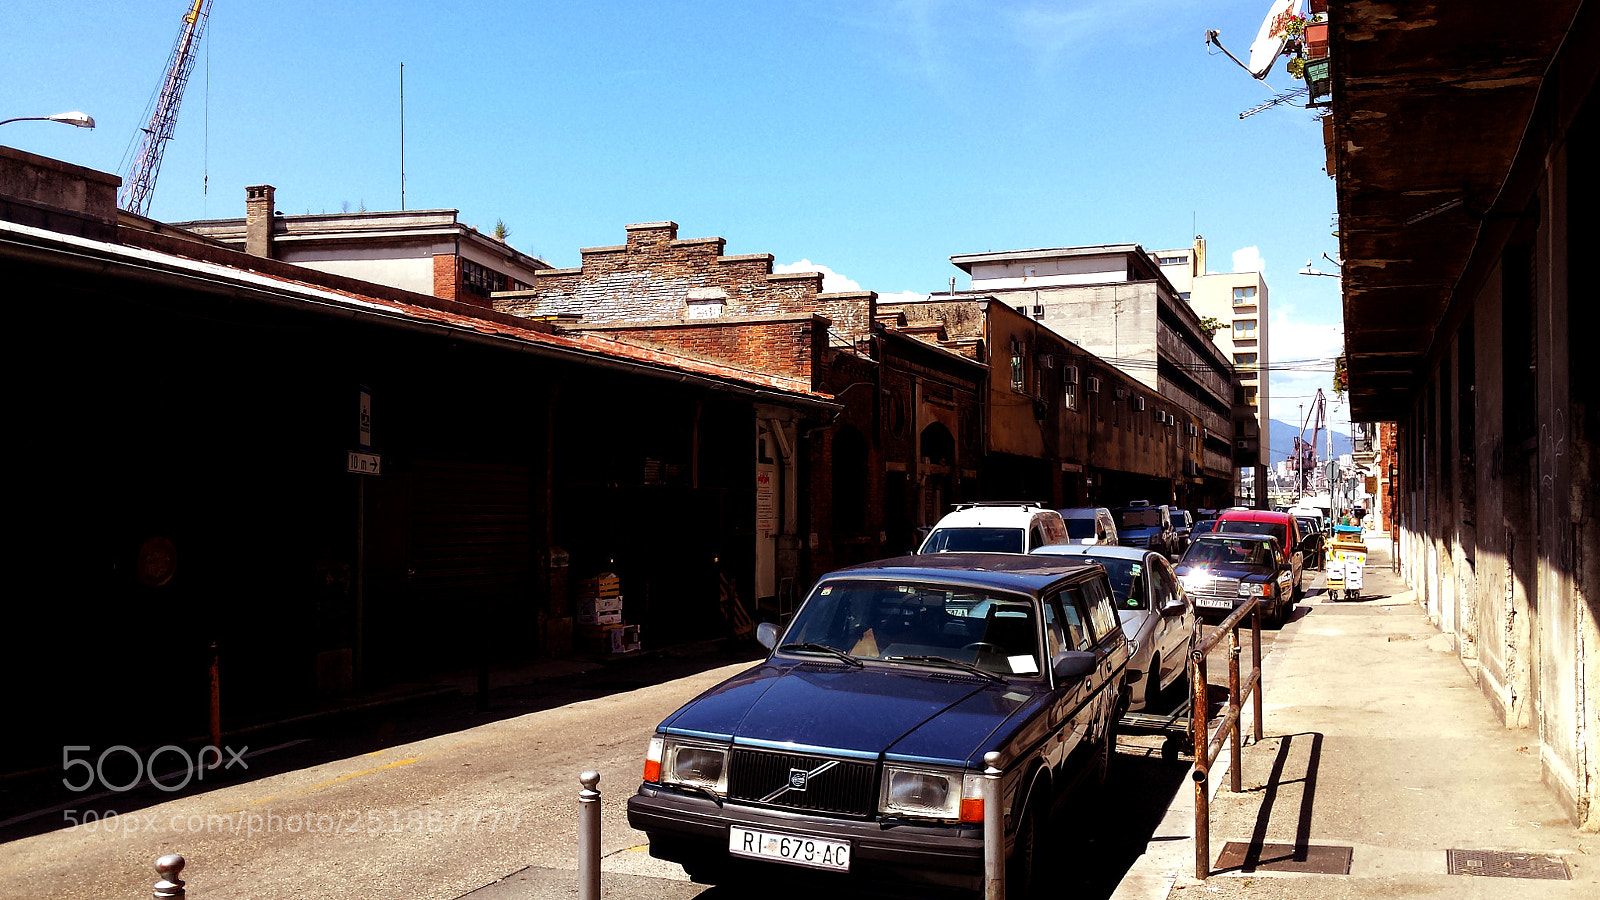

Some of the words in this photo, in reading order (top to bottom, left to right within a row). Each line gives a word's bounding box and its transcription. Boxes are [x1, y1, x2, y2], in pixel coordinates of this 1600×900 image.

[351, 454, 358, 469] 10
[361, 460, 367, 470] m
[743, 832, 762, 853] RI
